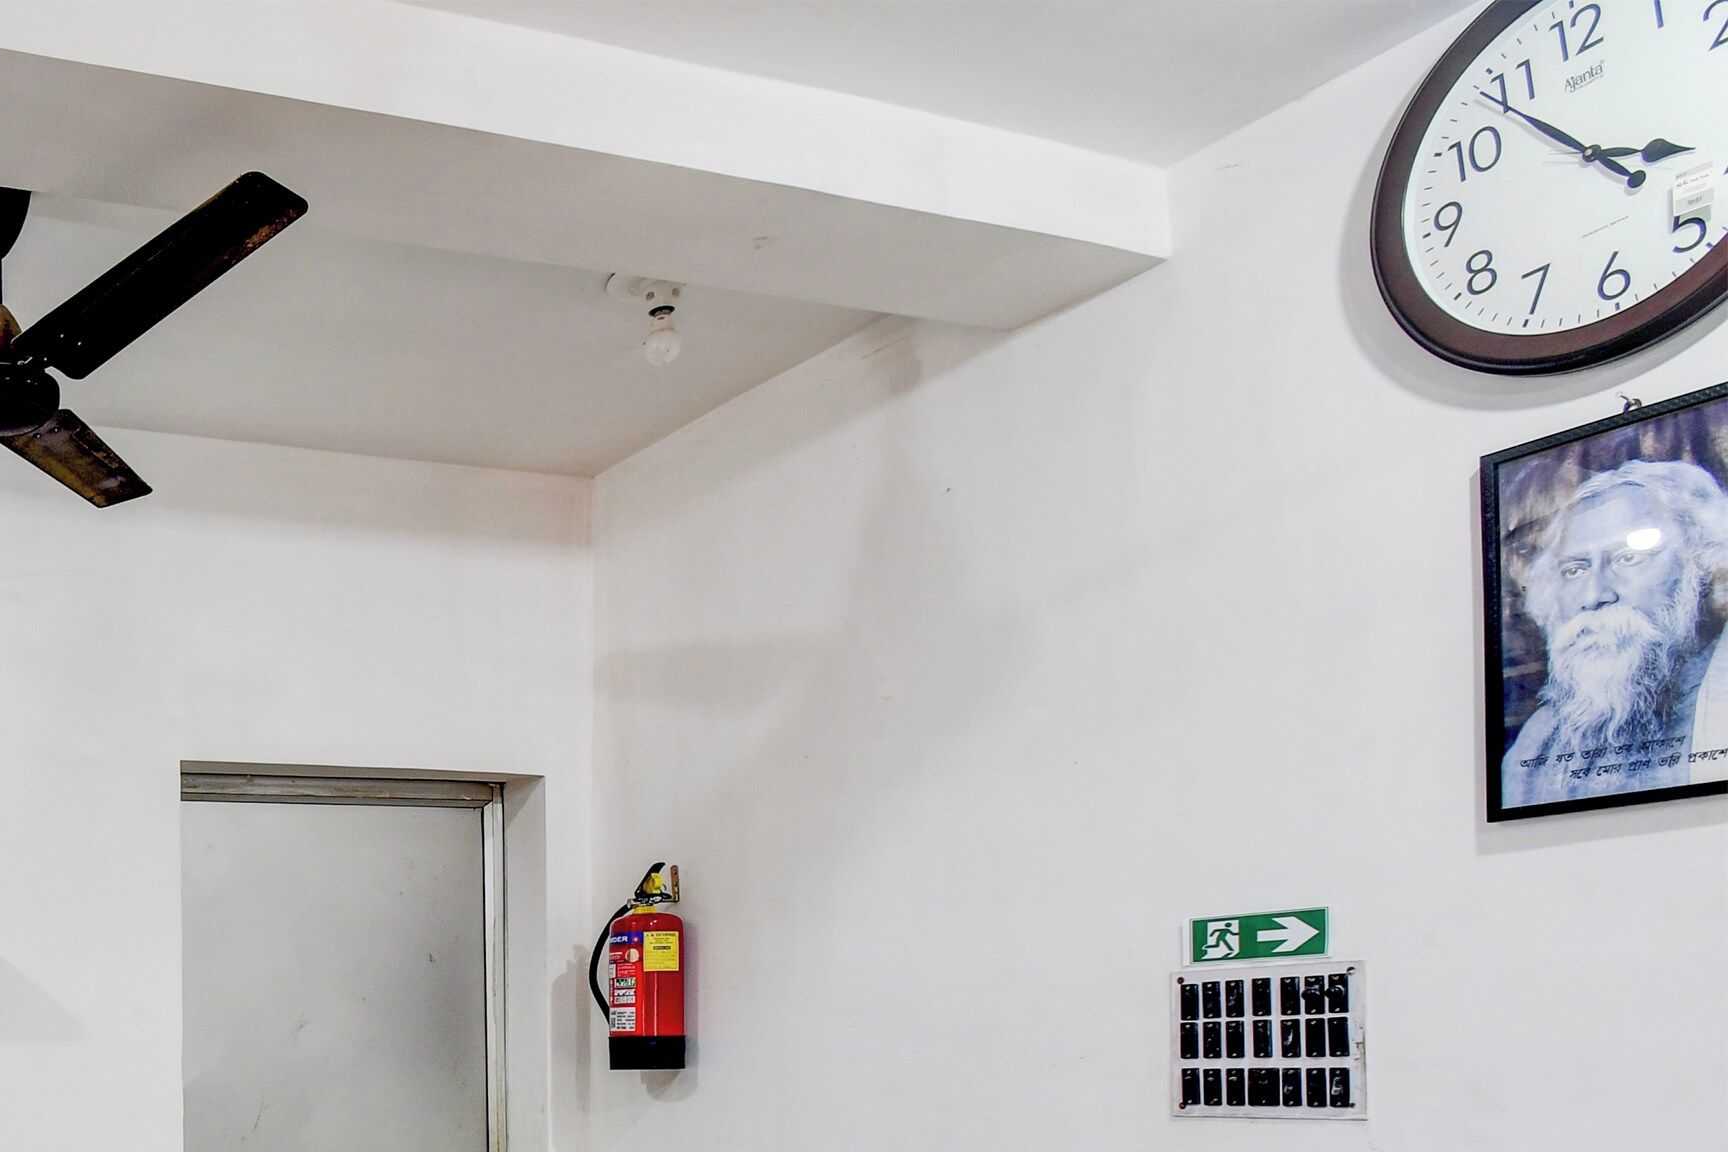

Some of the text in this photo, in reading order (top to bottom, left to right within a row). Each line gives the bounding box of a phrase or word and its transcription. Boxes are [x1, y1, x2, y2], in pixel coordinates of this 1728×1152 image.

[1549, 3, 1604, 63] 12
[1489, 58, 1536, 115] 11
[1563, 63, 1604, 93] Ajanta
[1447, 125, 1503, 184] 10
[1433, 200, 1464, 249] 9
[1672, 215, 1708, 254] 5
[1465, 249, 1498, 296] 8
[1520, 262, 1552, 316] 7
[1596, 250, 1632, 301] 6
